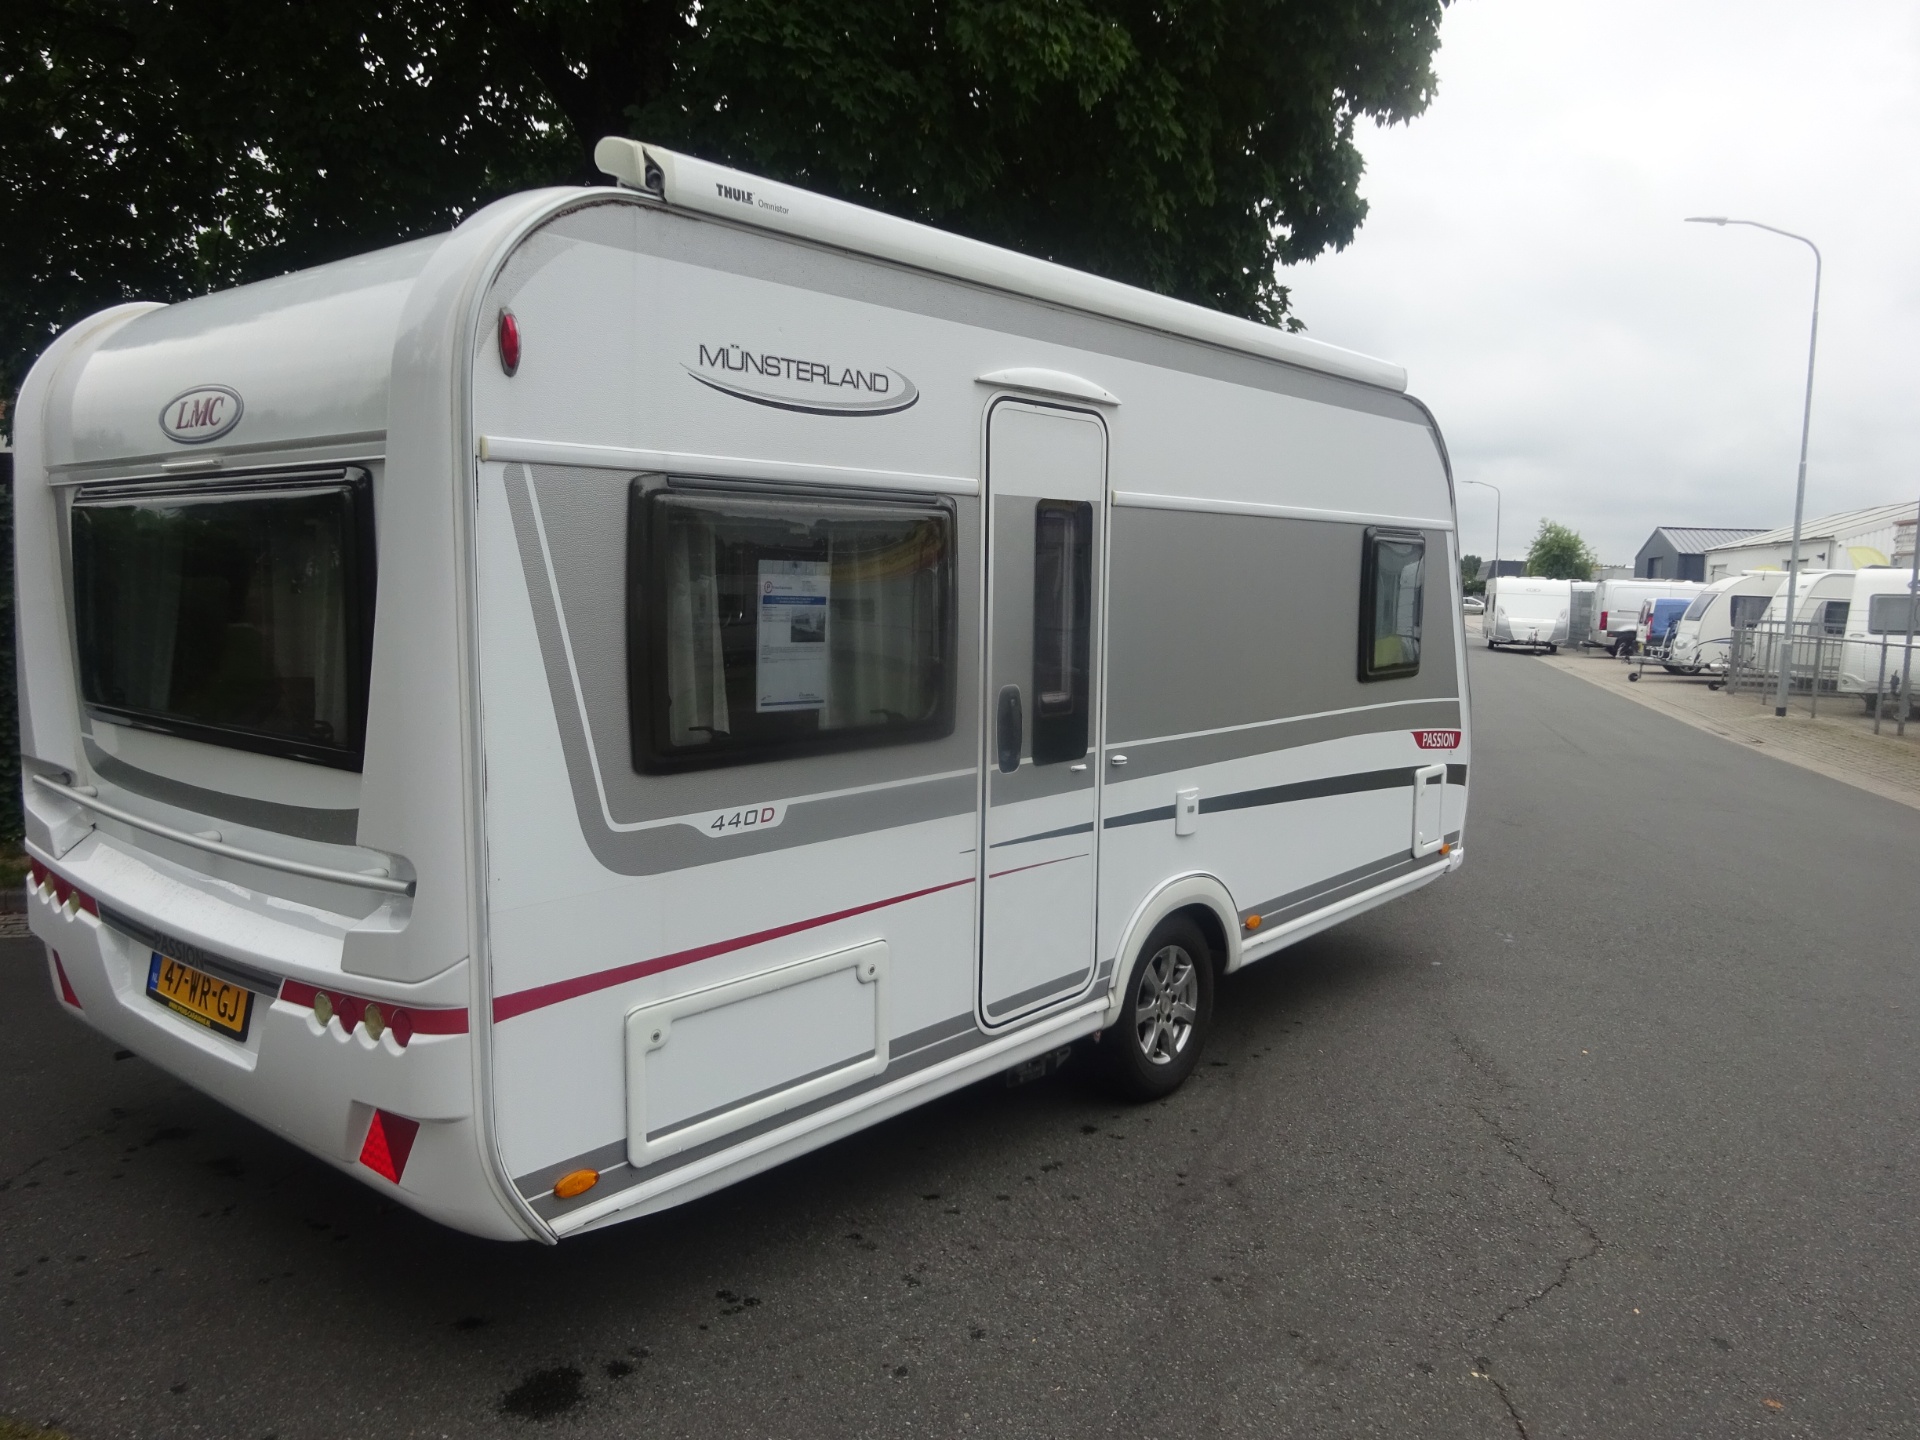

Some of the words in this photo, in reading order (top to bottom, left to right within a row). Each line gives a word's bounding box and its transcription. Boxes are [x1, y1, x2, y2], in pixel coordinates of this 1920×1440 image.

[716, 182, 753, 205] THULE
[758, 199, 790, 215] Omnistor
[699, 344, 890, 393] MÜNSTERLAND
[176, 396, 224, 429] LMC
[1422, 732, 1455, 747] PASSION
[711, 807, 775, 830] 440D
[165, 962, 240, 1022] 47-WR-GJ
